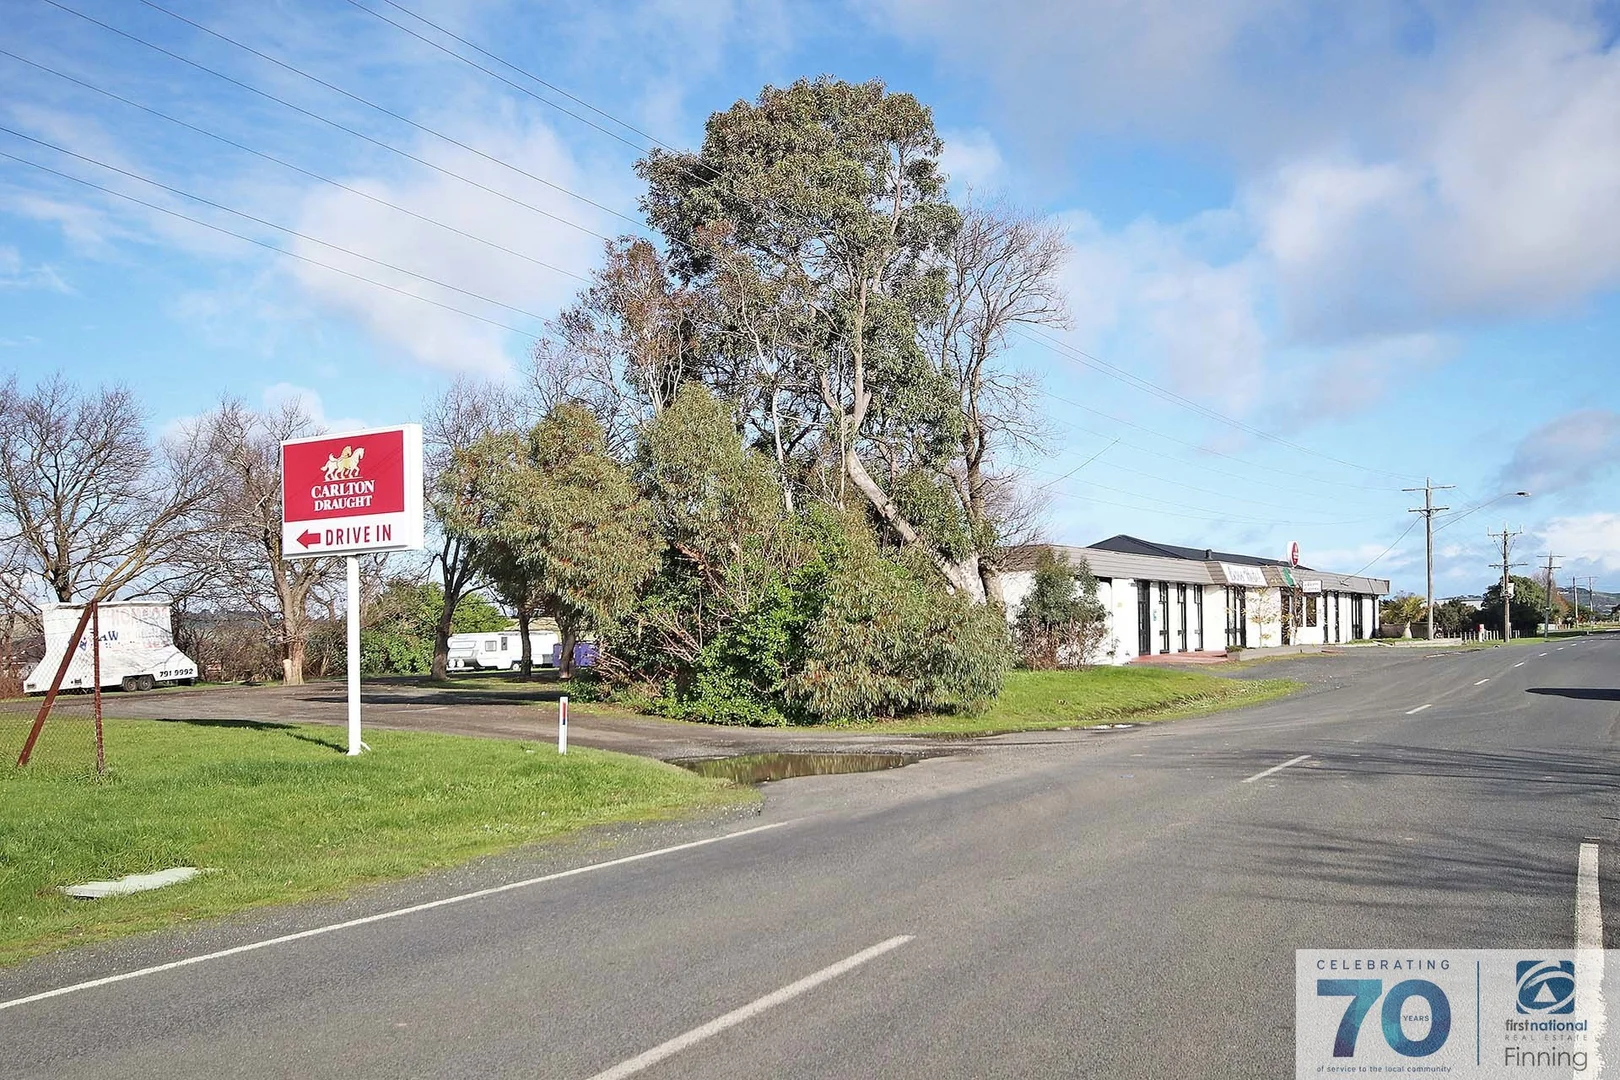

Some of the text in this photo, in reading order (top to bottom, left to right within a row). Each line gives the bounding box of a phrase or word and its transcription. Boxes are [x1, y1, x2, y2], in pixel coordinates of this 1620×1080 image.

[311, 480, 375, 499] CARLTON
[313, 495, 373, 512] DRAUGHT
[325, 524, 392, 546] DRIVE IN
[159, 670, 172, 678] 791
